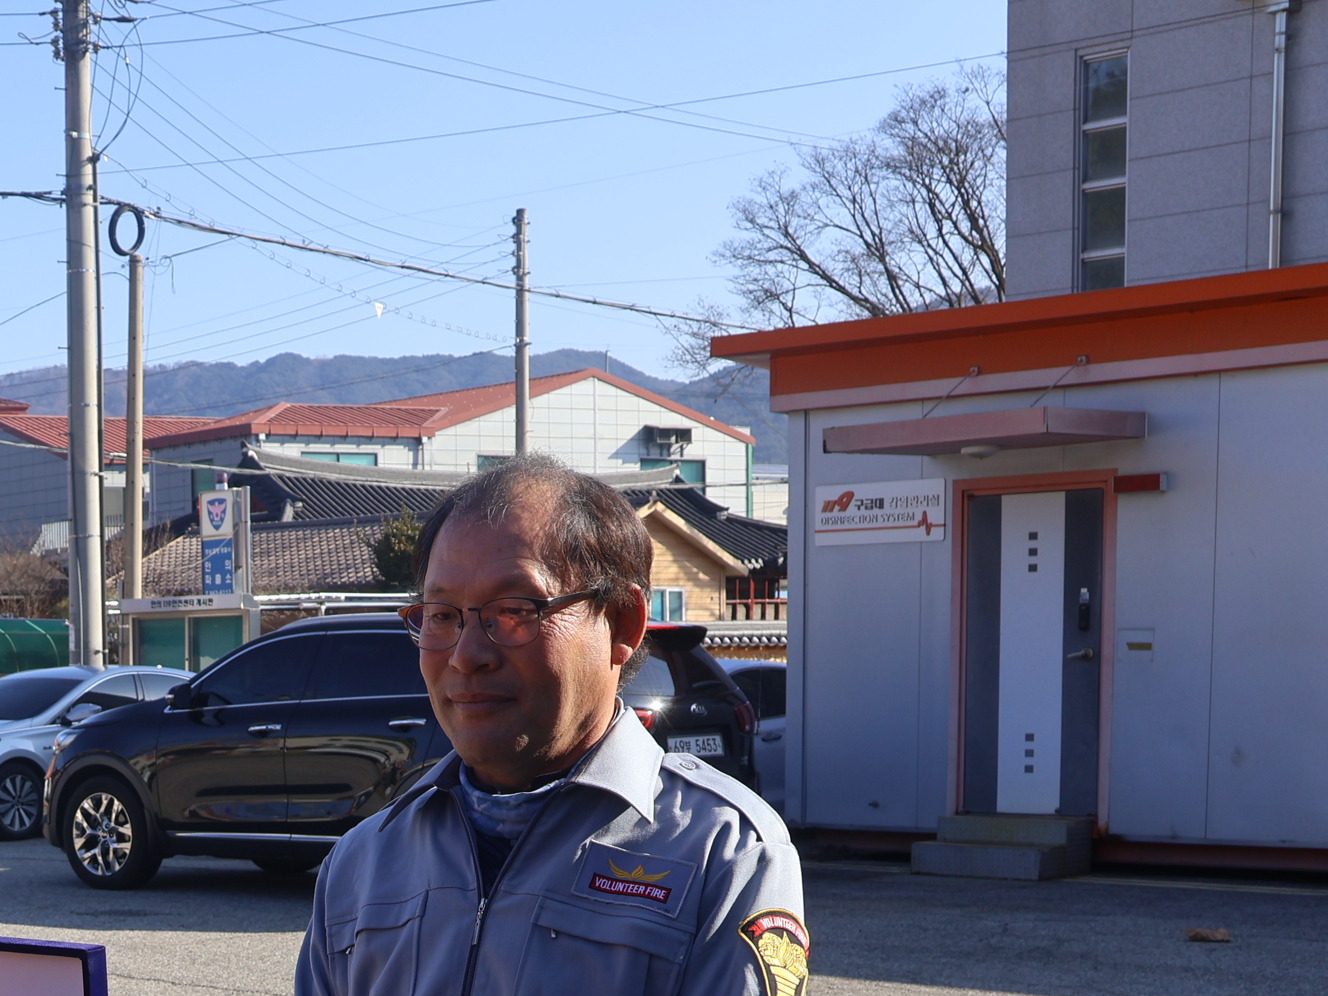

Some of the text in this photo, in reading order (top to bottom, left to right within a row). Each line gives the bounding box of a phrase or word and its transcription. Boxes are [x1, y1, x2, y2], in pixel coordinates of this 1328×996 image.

[821, 490, 855, 513] 119
[854, 497, 885, 511] 구급대
[821, 512, 915, 526] DISINFECTION SYSTEM
[695, 738, 718, 753] 5453
[595, 876, 668, 900] VOLUNTEER FIRE
[760, 916, 797, 932] VOLUNTEER
